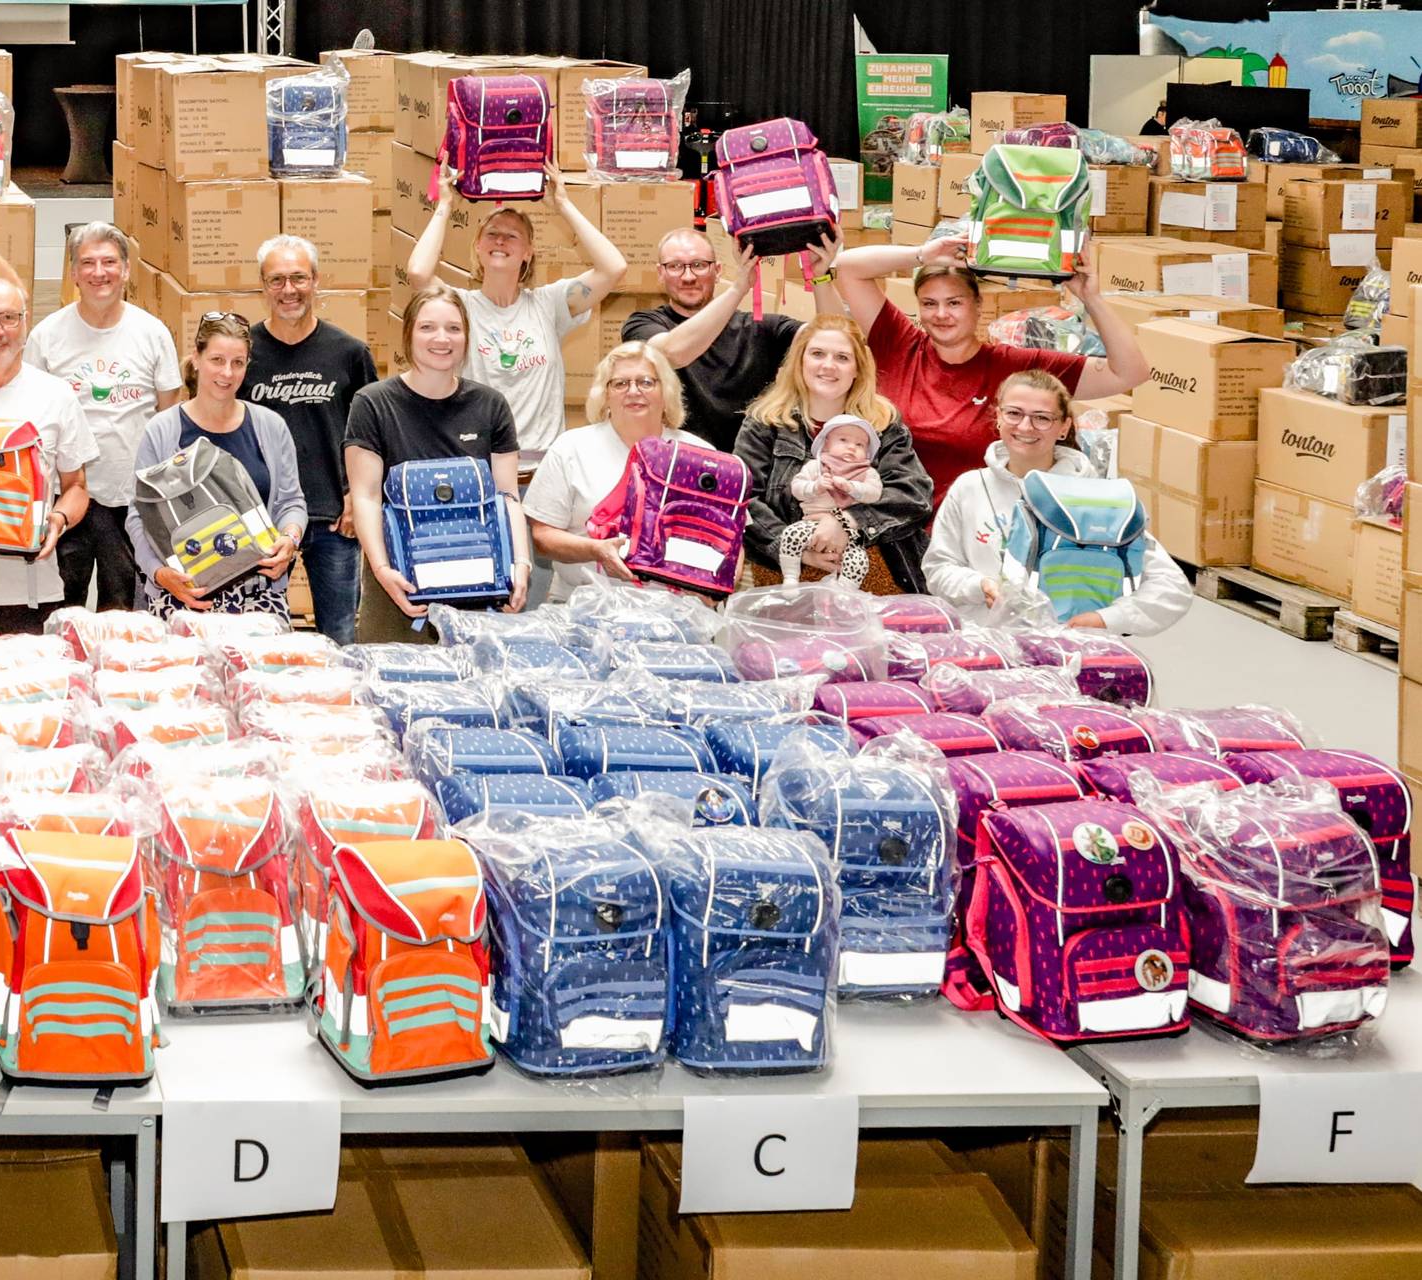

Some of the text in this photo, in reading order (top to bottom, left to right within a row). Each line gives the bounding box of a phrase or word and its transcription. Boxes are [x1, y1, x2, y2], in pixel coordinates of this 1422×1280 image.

[1111, 274, 1138, 290] tonton
[271, 371, 322, 383] Kinderglück
[1189, 377, 1197, 392] 2
[251, 381, 337, 402] Original
[1281, 428, 1336, 458] tonton
[1328, 1111, 1356, 1153] F
[234, 1139, 269, 1182] D
[753, 1133, 787, 1177] C
